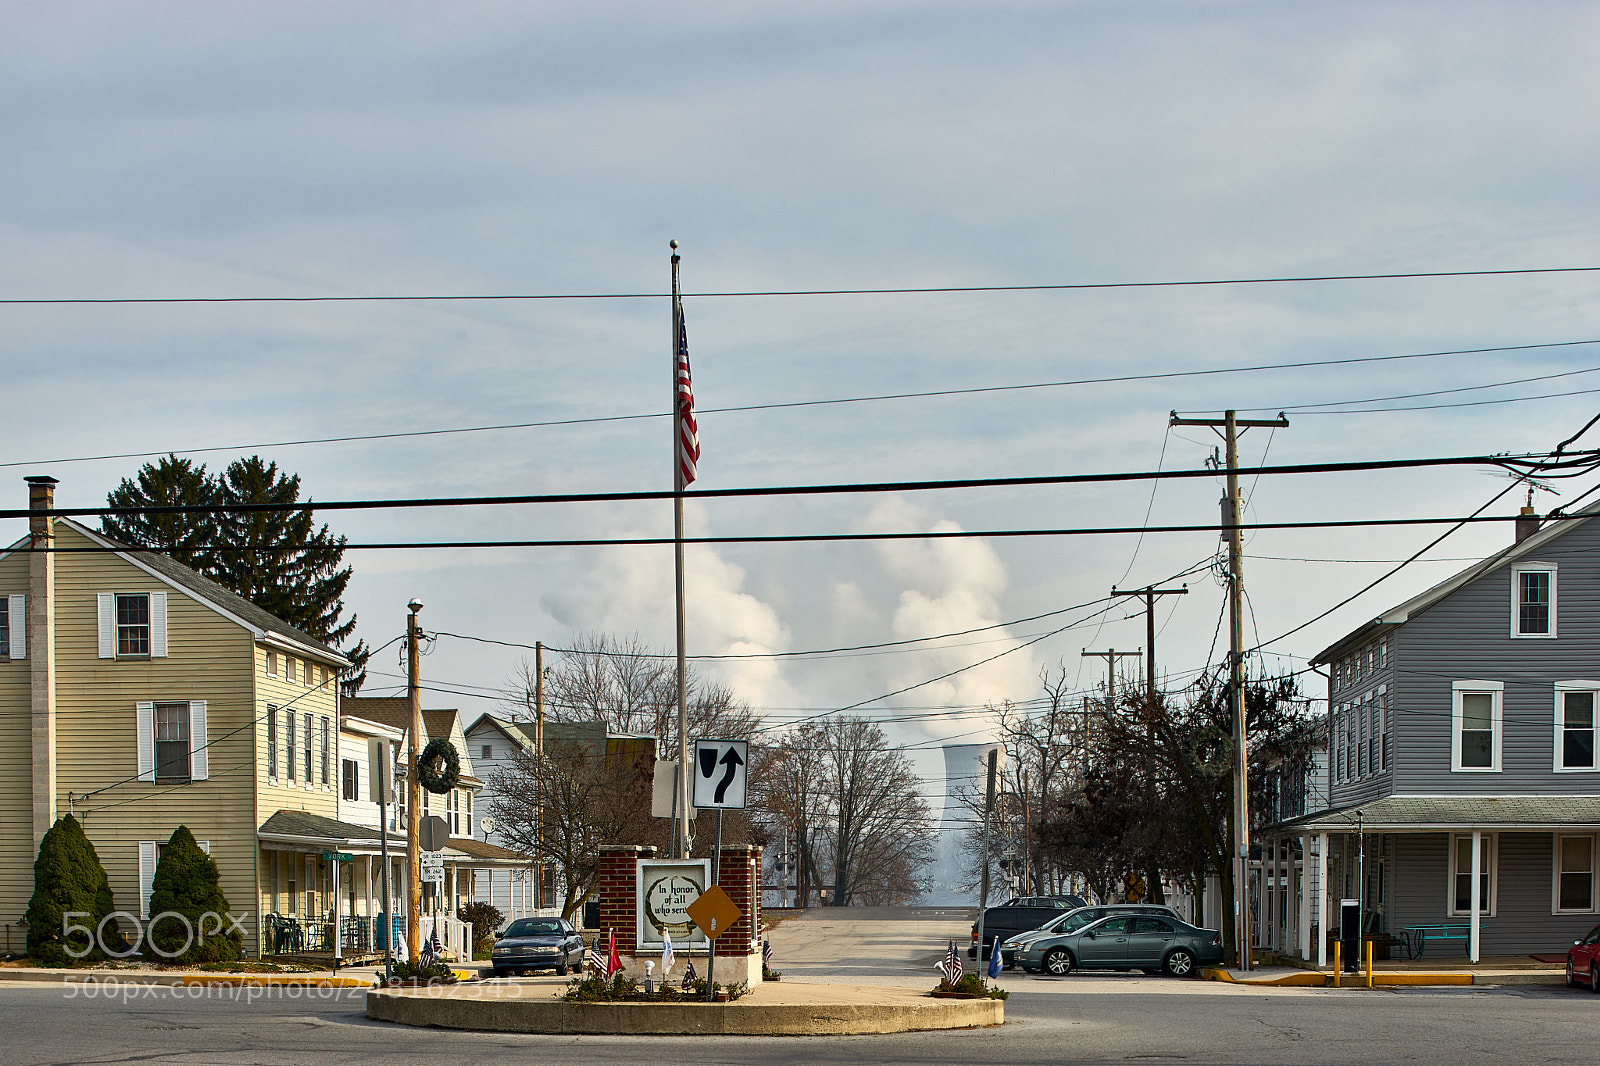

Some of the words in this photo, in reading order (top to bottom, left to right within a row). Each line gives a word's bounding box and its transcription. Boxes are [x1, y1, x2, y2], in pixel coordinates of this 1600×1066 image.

[659, 884, 667, 894] In
[671, 876, 695, 896] honor
[664, 894, 672, 906] of
[674, 895, 686, 904] all
[655, 903, 670, 917] who
